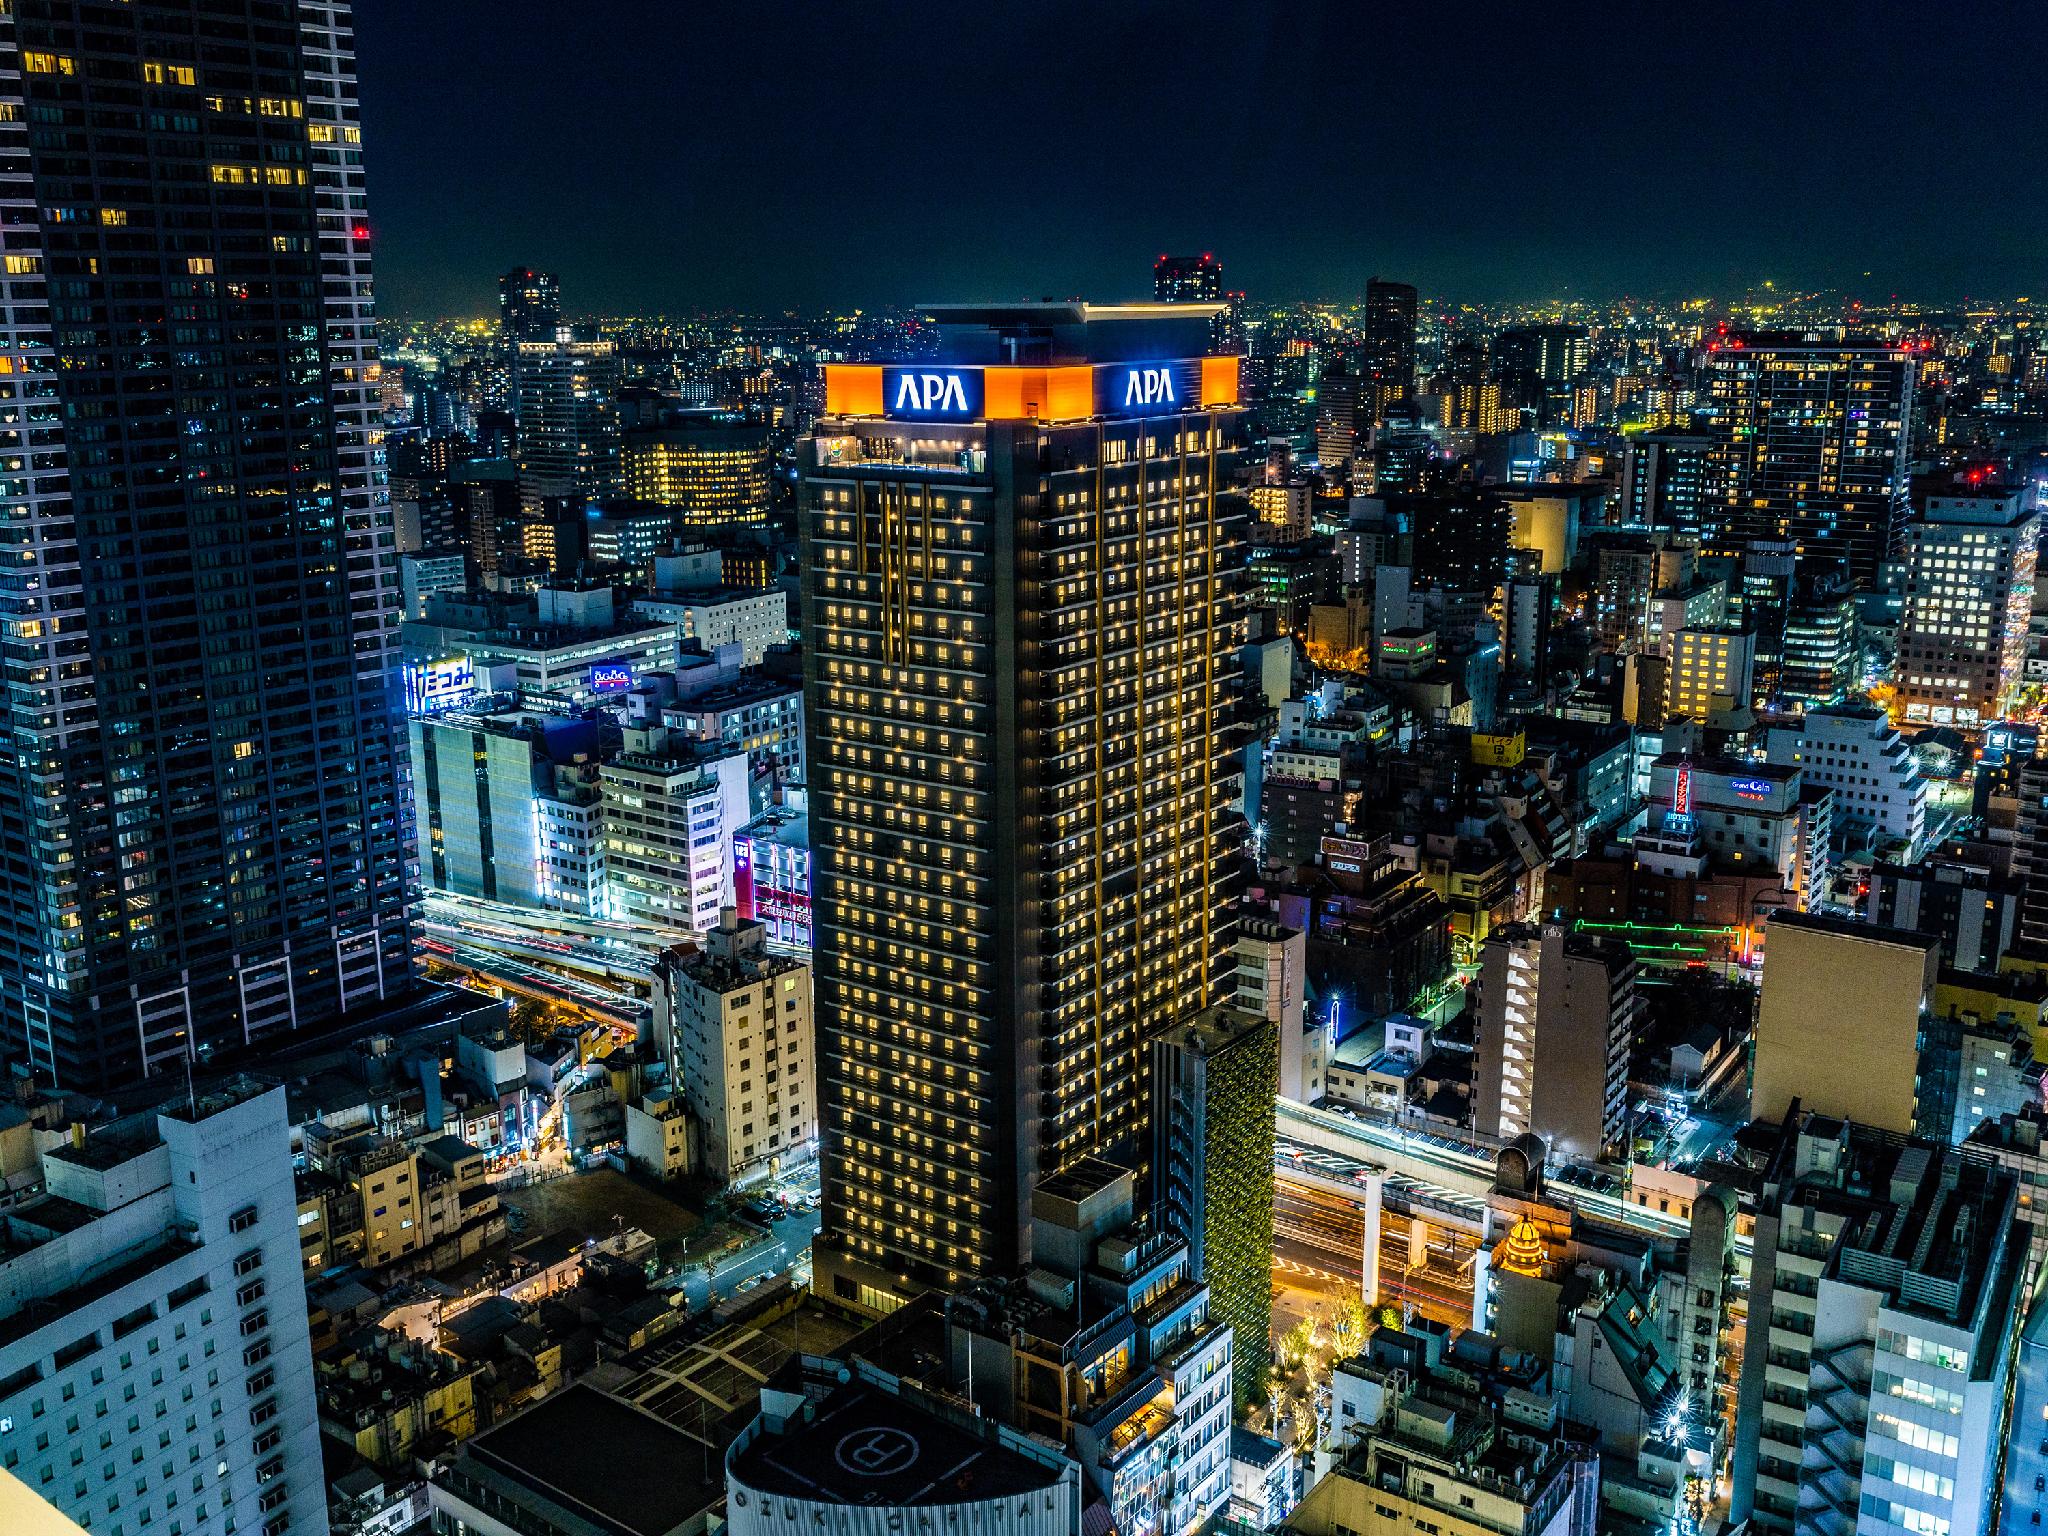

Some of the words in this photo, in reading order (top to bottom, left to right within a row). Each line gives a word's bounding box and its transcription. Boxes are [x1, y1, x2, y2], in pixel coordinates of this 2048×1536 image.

[896, 374, 968, 411] APA
[1126, 368, 1175, 406] APA
[417, 656, 474, 697] たつみ
[1667, 812, 1691, 822] HOTEL
[887, 1495, 1055, 1530] CAPITAL
